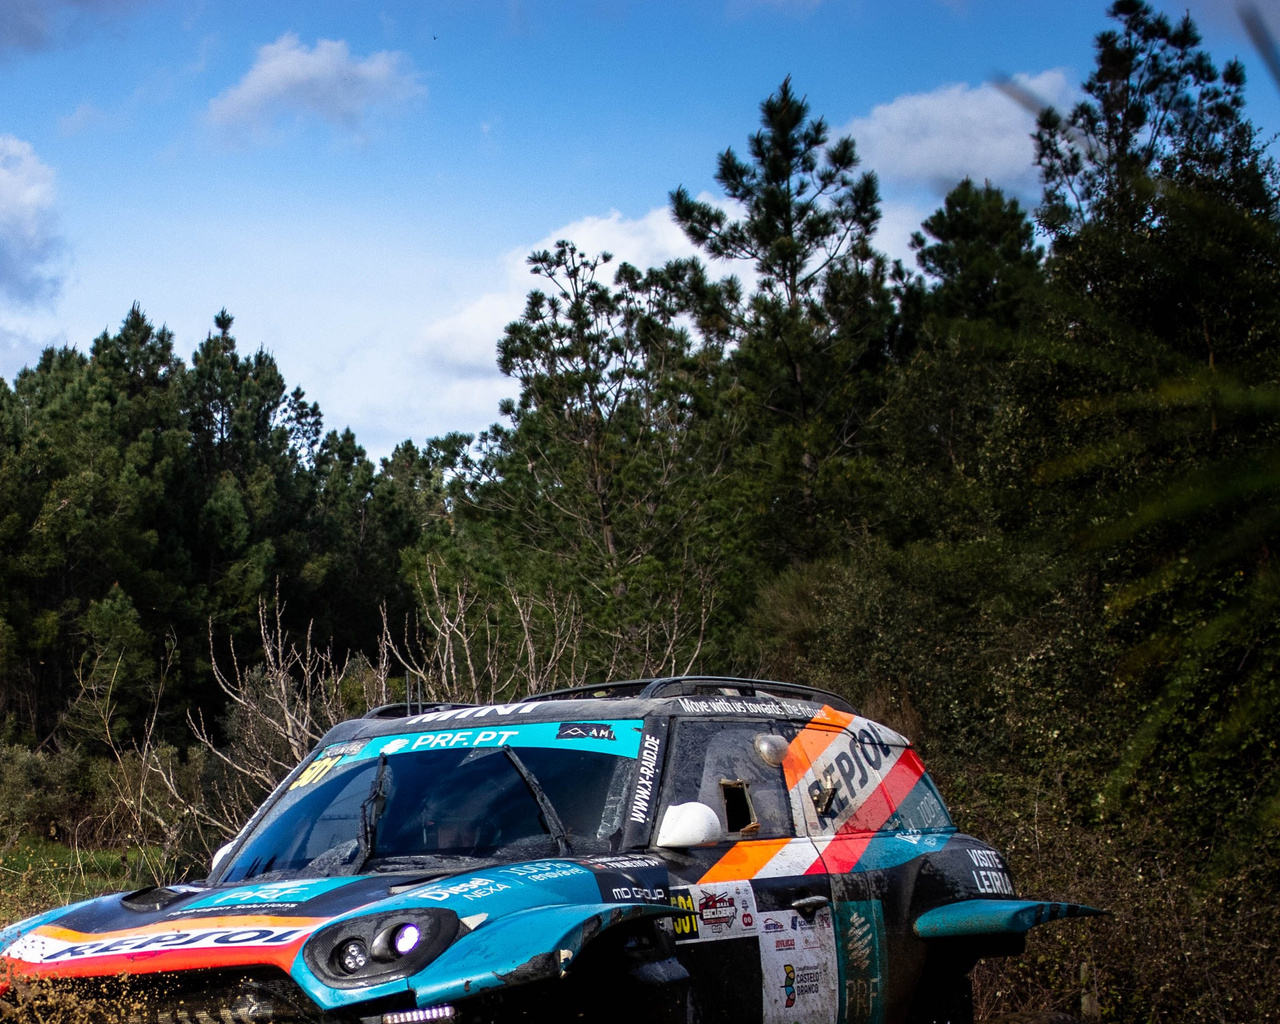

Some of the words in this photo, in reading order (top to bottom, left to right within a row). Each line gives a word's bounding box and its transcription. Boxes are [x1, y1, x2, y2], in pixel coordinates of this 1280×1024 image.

[678, 698, 710, 713] Move
[711, 699, 732, 713] with
[732, 702, 746, 713] us
[745, 701, 783, 715] towards
[782, 702, 799, 714] the
[411, 731, 519, 750] PRF.PT
[289, 755, 342, 790] 501
[631, 735, 660, 823] WWW.X-RAID.DE
[808, 722, 891, 830] REPSOL
[966, 849, 1003, 868] VISITE
[418, 877, 496, 901] Diesel
[463, 883, 511, 900] NEXA
[972, 871, 1015, 895] LEIRIA
[214, 887, 310, 904] PRF
[612, 887, 632, 899] MD
[43, 929, 303, 960] REPSOL
[796, 972, 819, 984] CASTELO
[797, 984, 818, 995] BRANCO
[845, 978, 879, 1019] PRF
